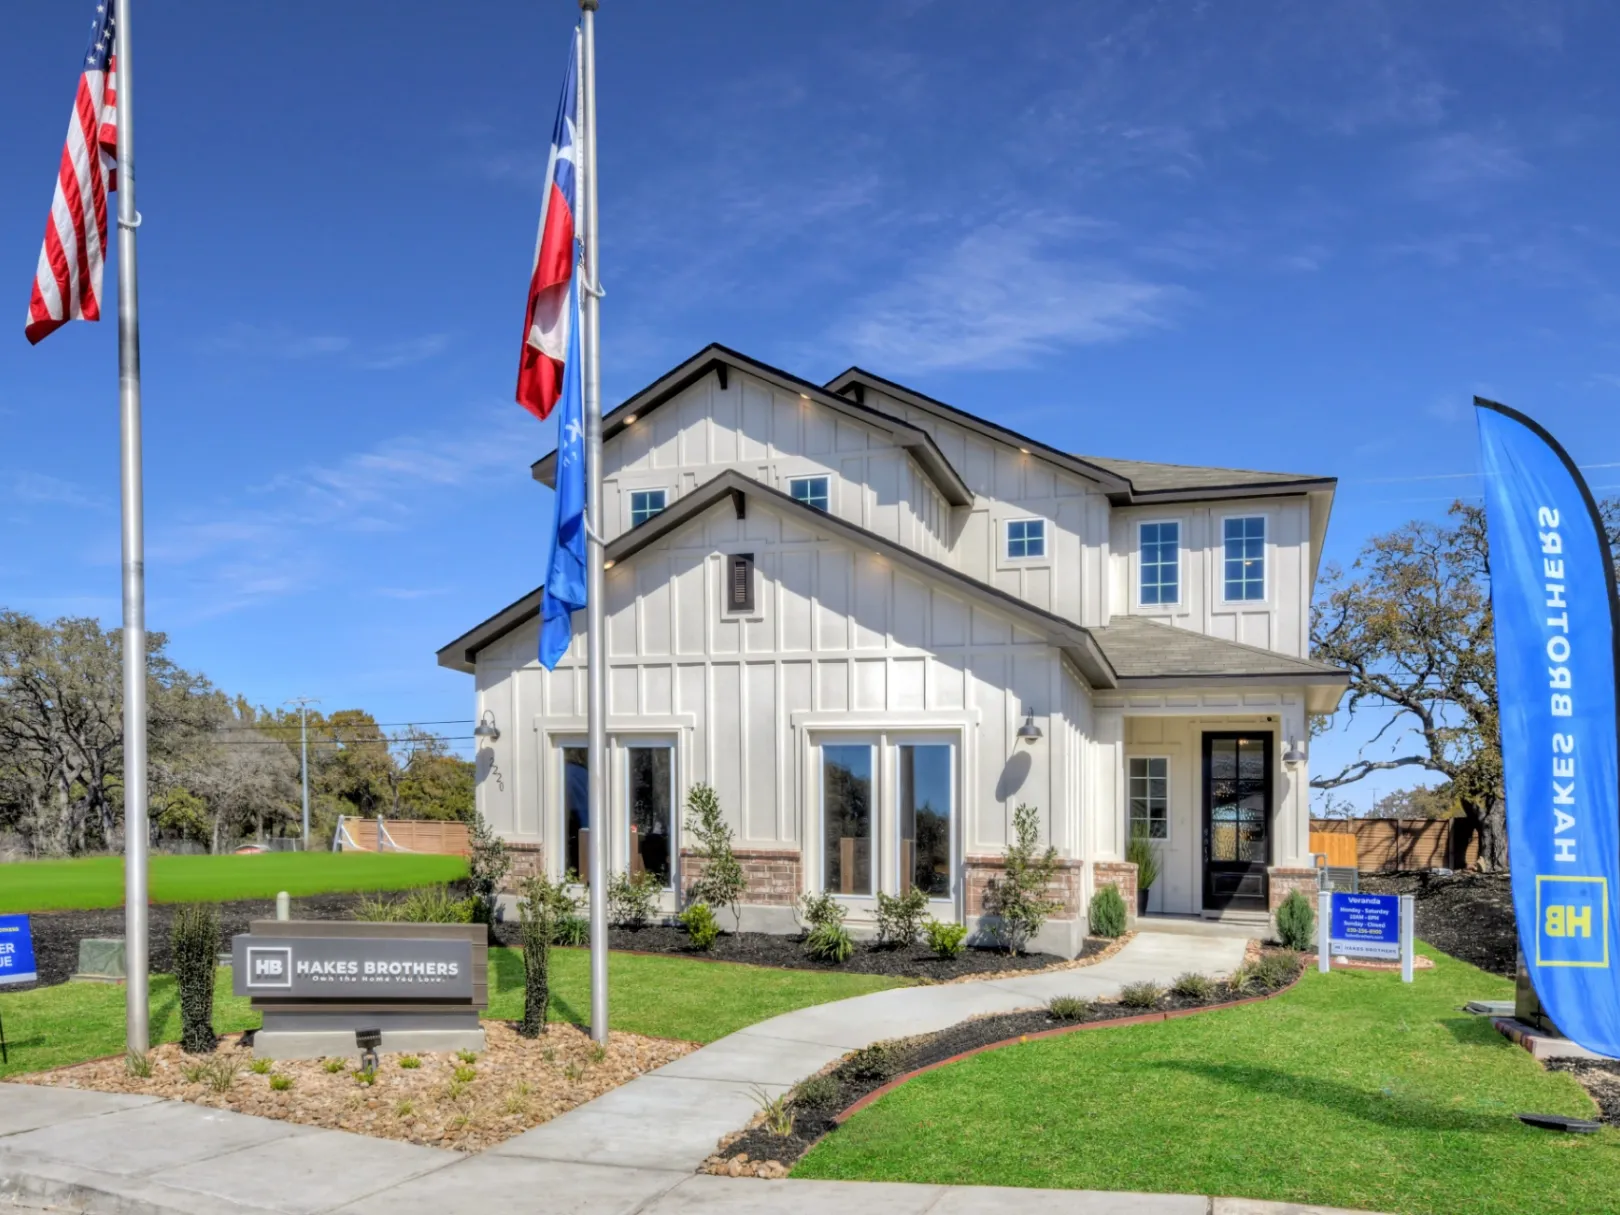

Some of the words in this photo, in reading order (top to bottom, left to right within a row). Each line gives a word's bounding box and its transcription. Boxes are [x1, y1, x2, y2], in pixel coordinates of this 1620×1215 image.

[255, 959, 283, 976] HB
[296, 960, 359, 975] HAKES
[364, 962, 459, 976] BROTHERS
